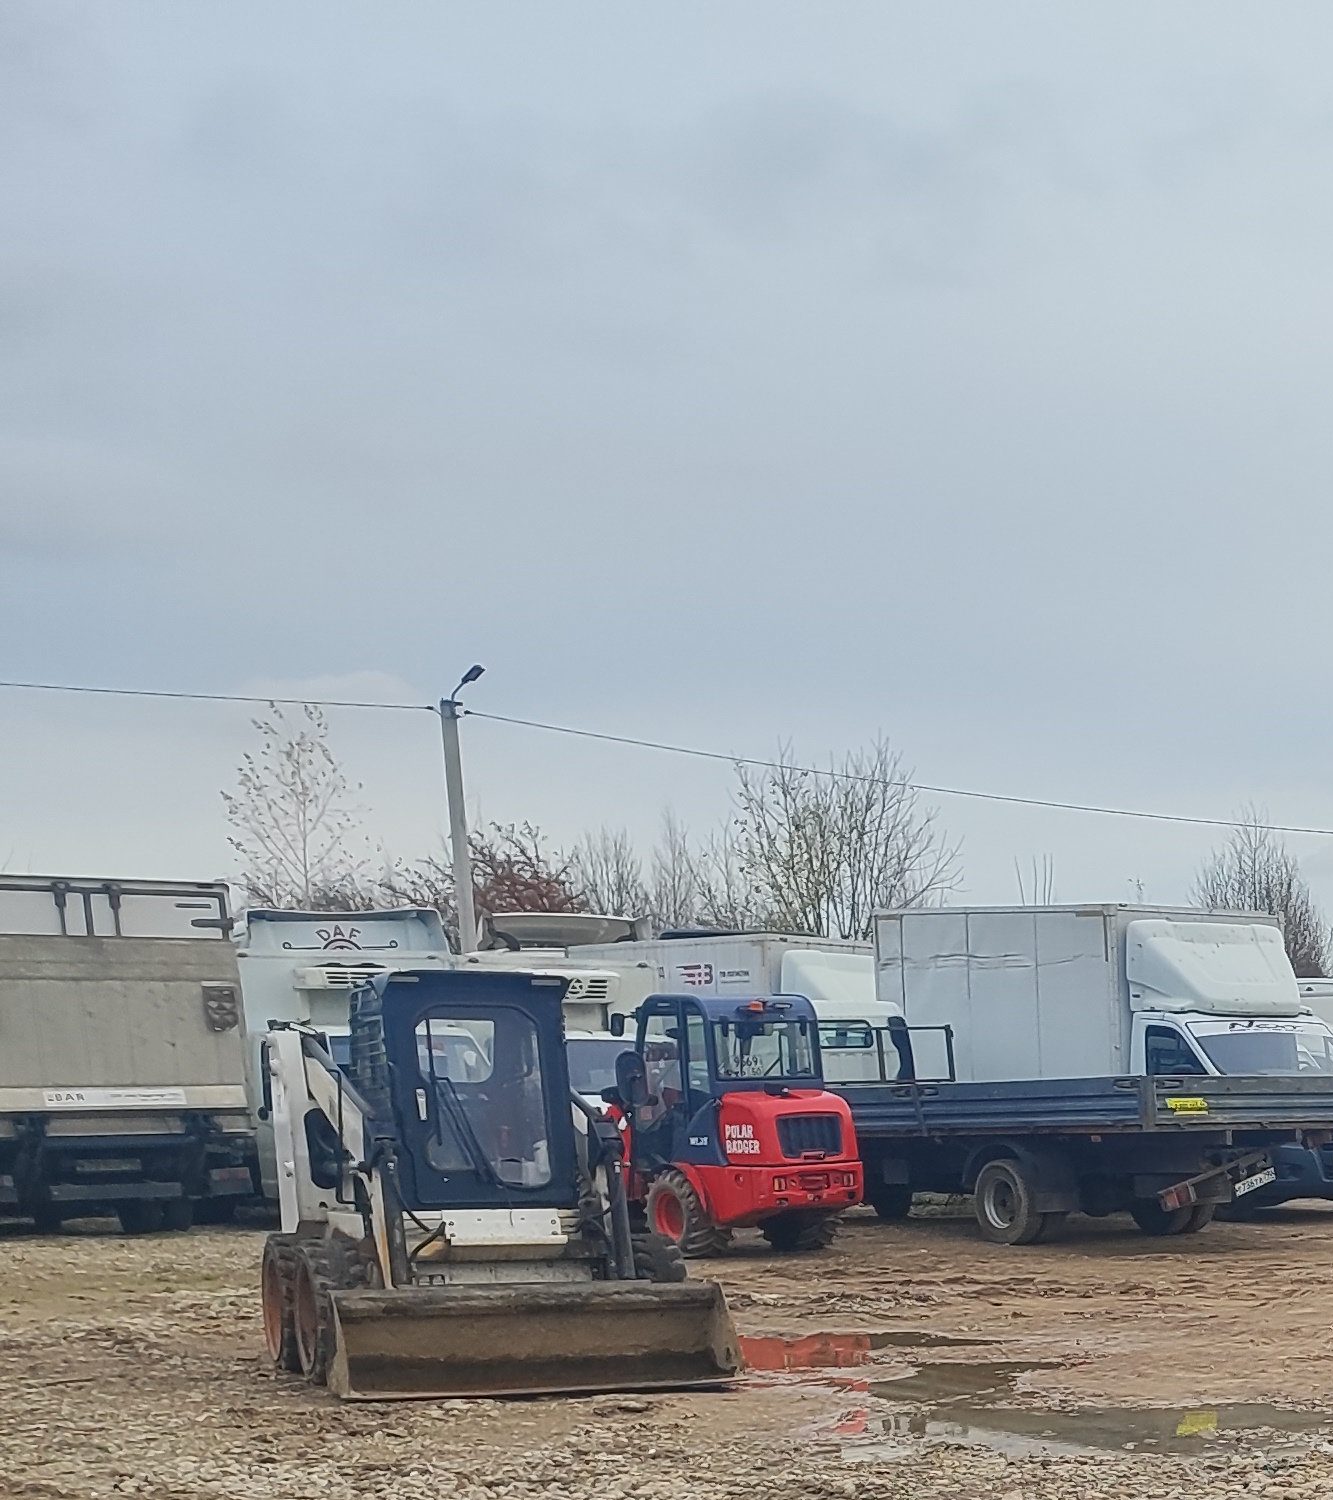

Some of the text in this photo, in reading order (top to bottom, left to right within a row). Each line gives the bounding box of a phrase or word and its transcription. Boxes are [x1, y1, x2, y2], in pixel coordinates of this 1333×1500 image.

[315, 925, 362, 941] DAF
[725, 1124, 754, 1139] POLAR
[726, 1139, 761, 1154] BADGER
